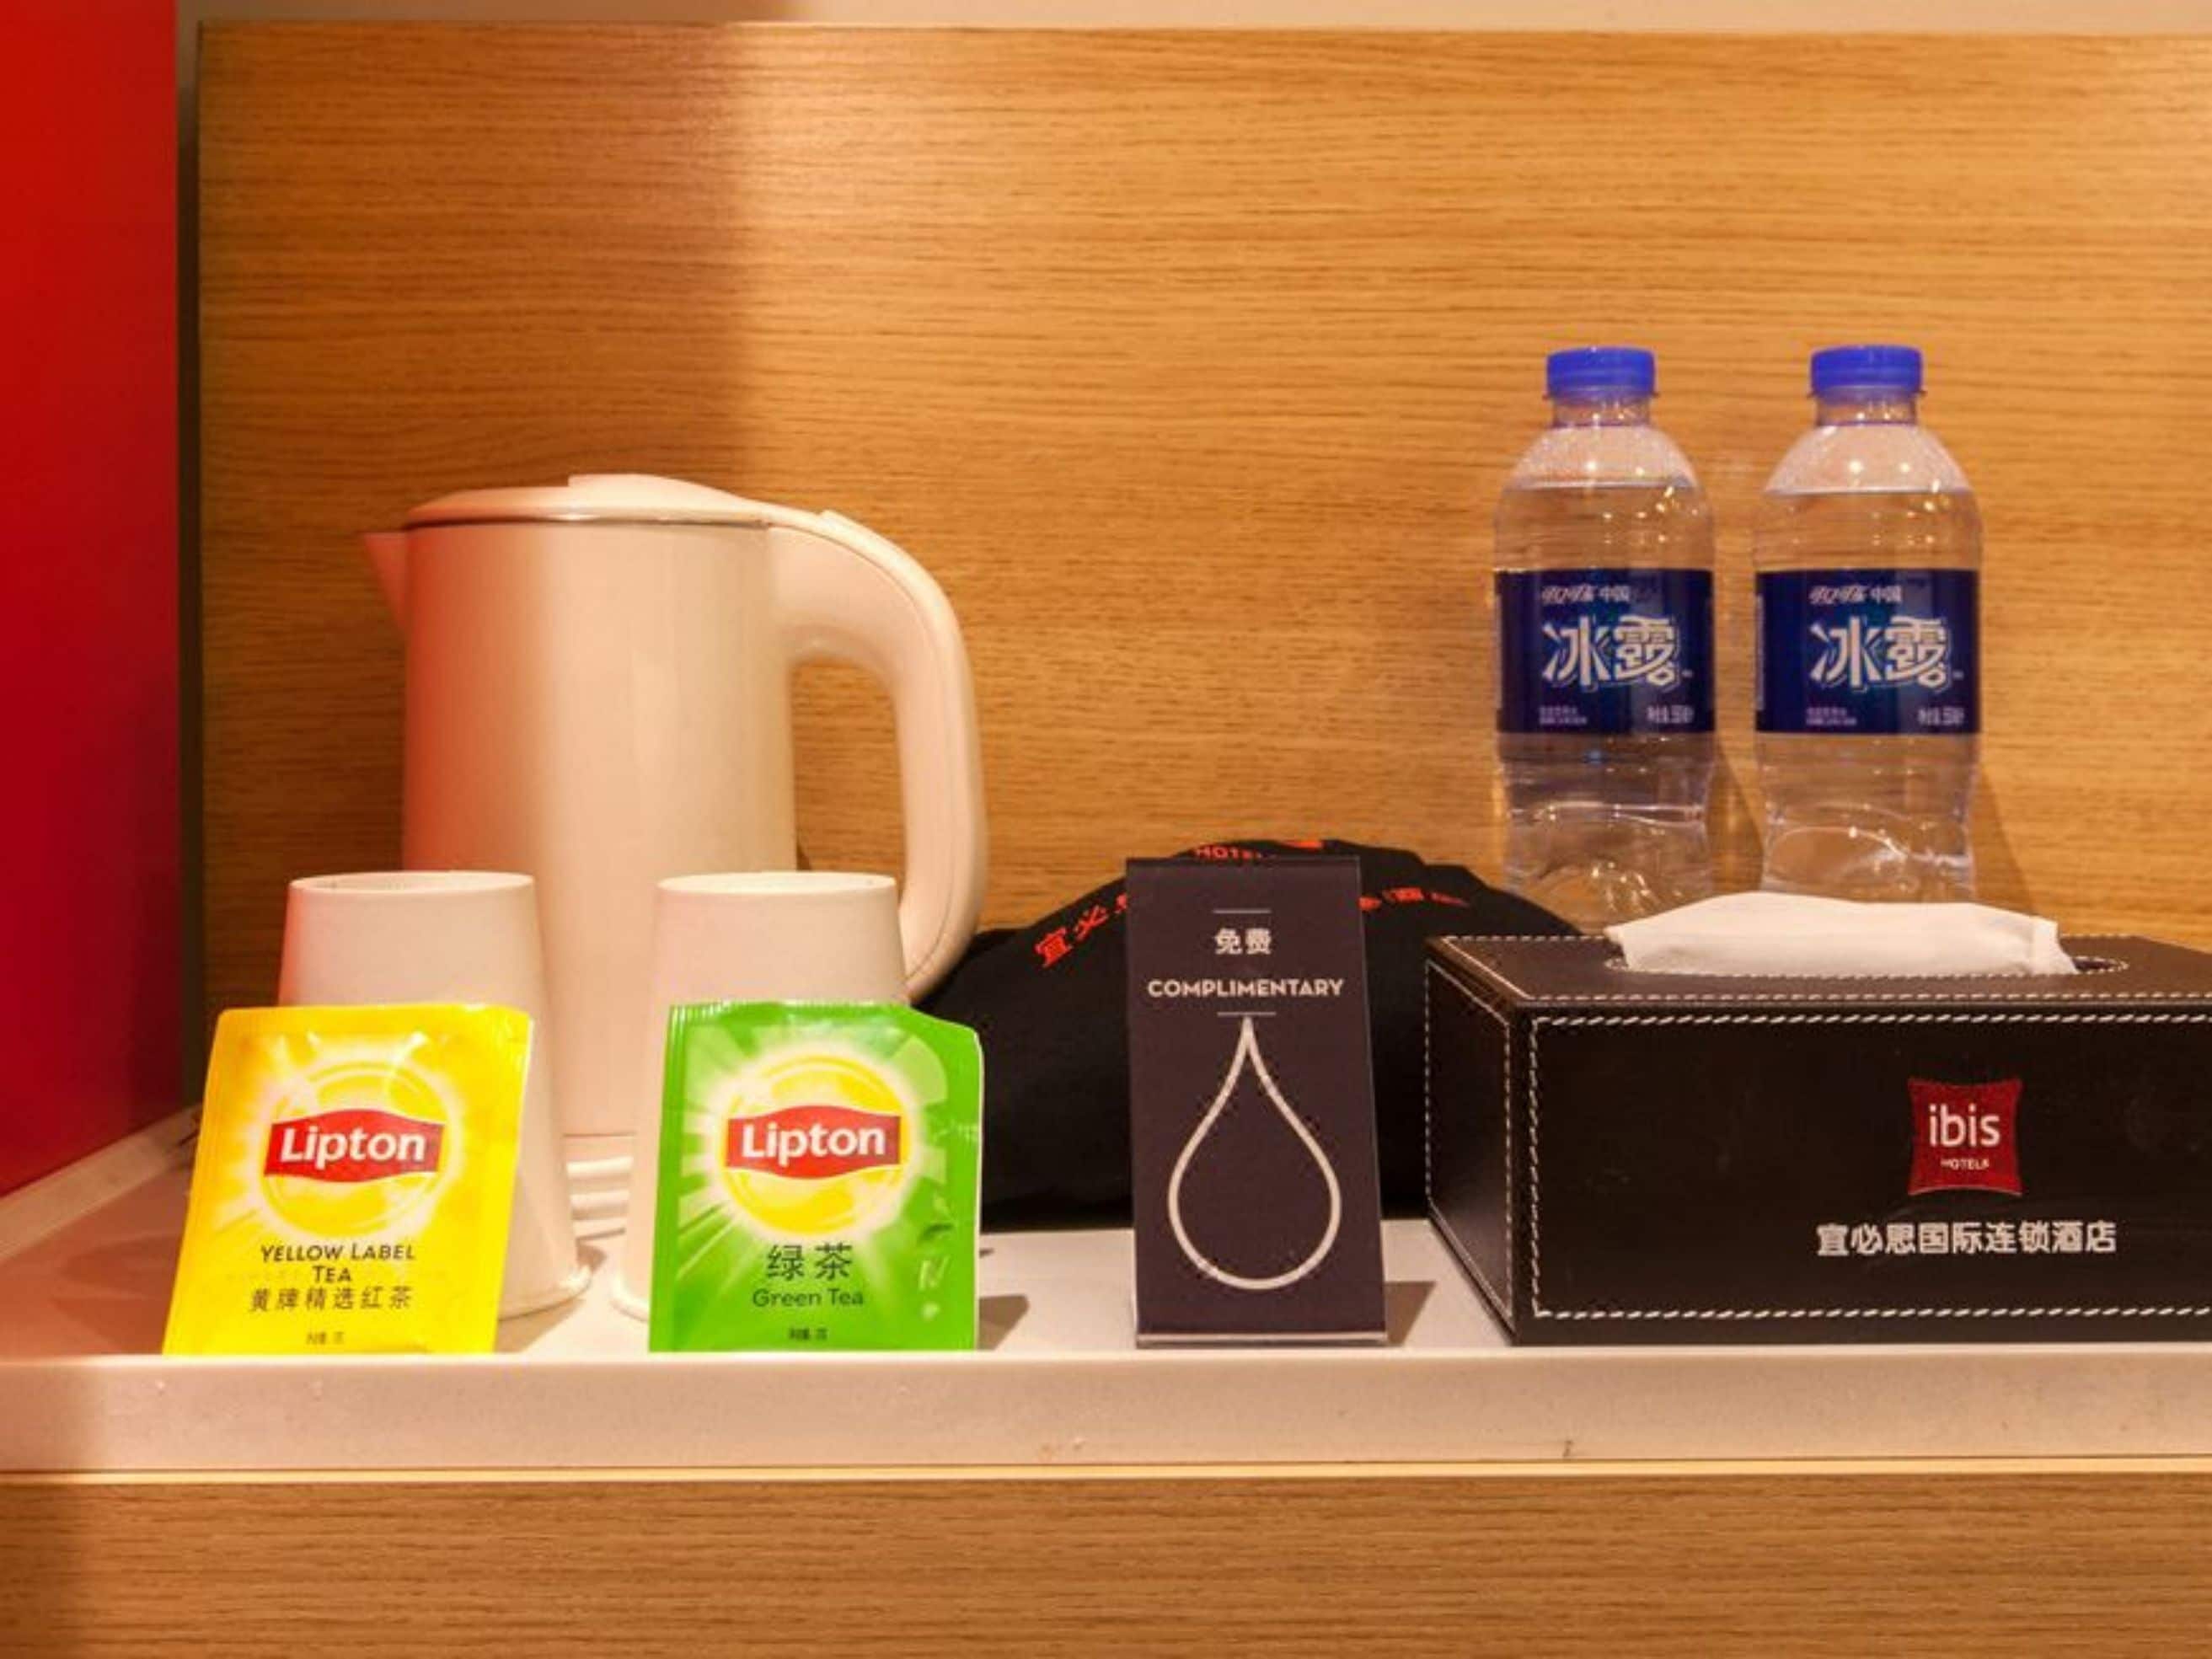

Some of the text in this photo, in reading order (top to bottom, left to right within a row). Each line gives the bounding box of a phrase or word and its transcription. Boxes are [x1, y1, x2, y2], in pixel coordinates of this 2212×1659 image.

[1541, 614, 1679, 693] 冰露
[1809, 614, 1952, 693] 冰露
[1213, 927, 1272, 955] 免费
[1147, 977, 1345, 998] COMPLIMENTARY
[1928, 1103, 2001, 1148] ibis
[280, 1126, 427, 1170] Lipton
[742, 1122, 886, 1168] Lipton
[260, 1242, 416, 1262] YELLOW LABEL
[1816, 1220, 2118, 1257] 宜必思国际连锁酒店
[312, 1265, 352, 1283] TEA
[766, 1242, 853, 1281] 绿茶
[250, 1286, 412, 1311] 黄牌精选红茶
[753, 1287, 865, 1308] Green Tea
